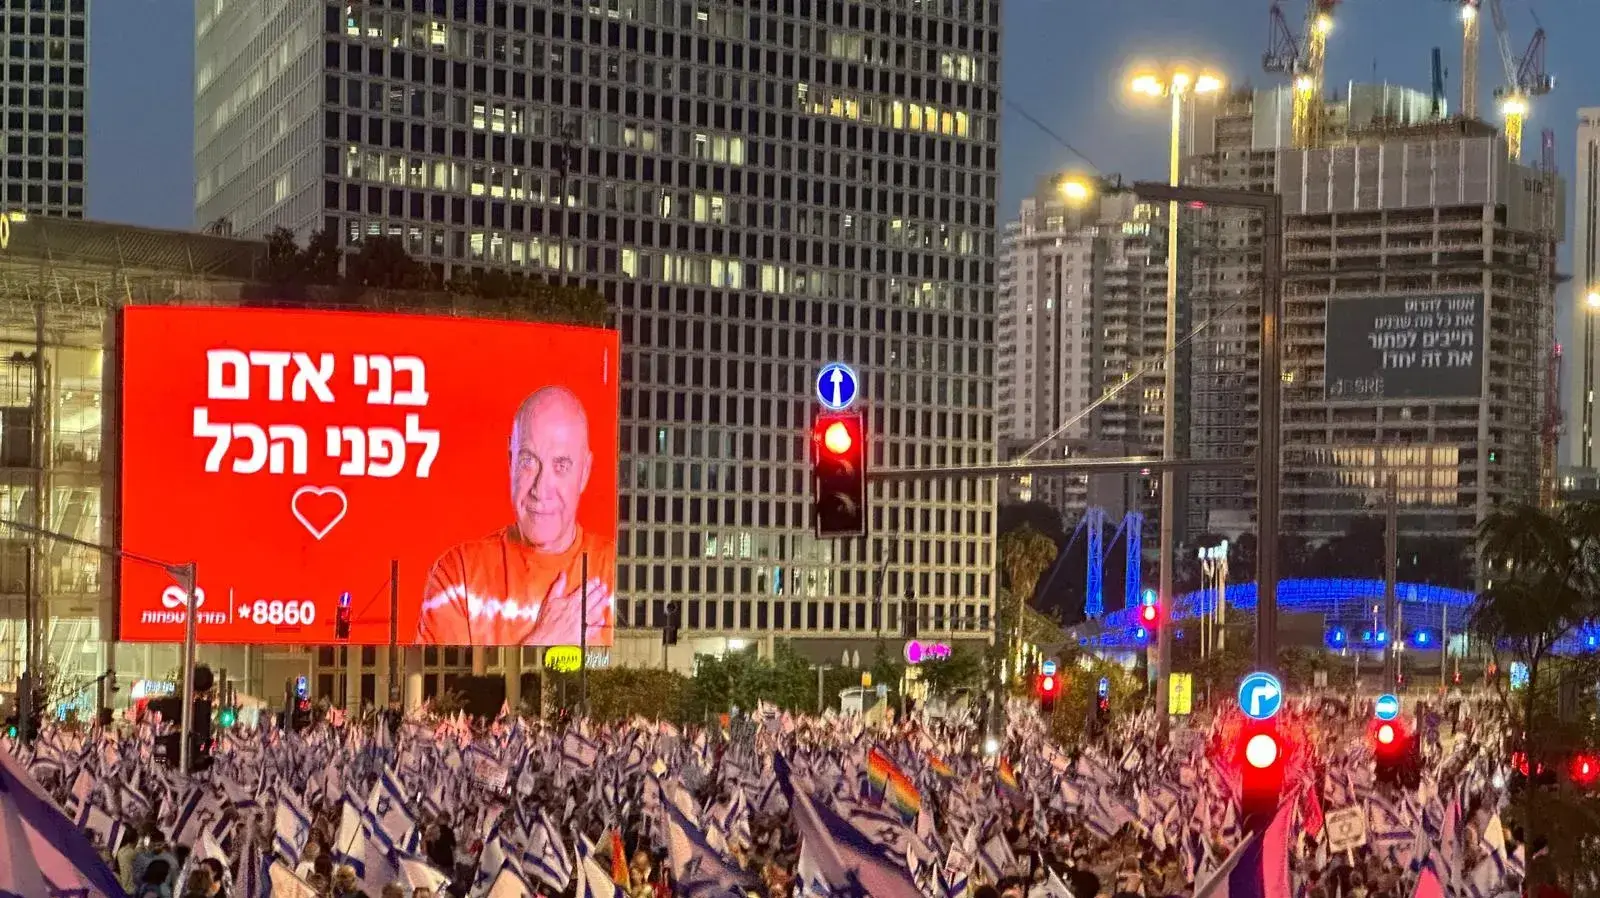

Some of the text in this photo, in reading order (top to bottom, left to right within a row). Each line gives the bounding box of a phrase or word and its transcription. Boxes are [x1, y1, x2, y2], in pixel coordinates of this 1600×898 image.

[1414, 313, 1433, 328] מה
[1437, 312, 1452, 328] כל
[1454, 312, 1475, 327] את
[1367, 329, 1474, 349] חייבים לפתור
[1420, 350, 1442, 368] זה
[1446, 350, 1474, 367] את
[206, 349, 430, 406] בני אדם
[193, 406, 441, 478] לפני הכל
[141, 610, 226, 624] מזר טפחות
